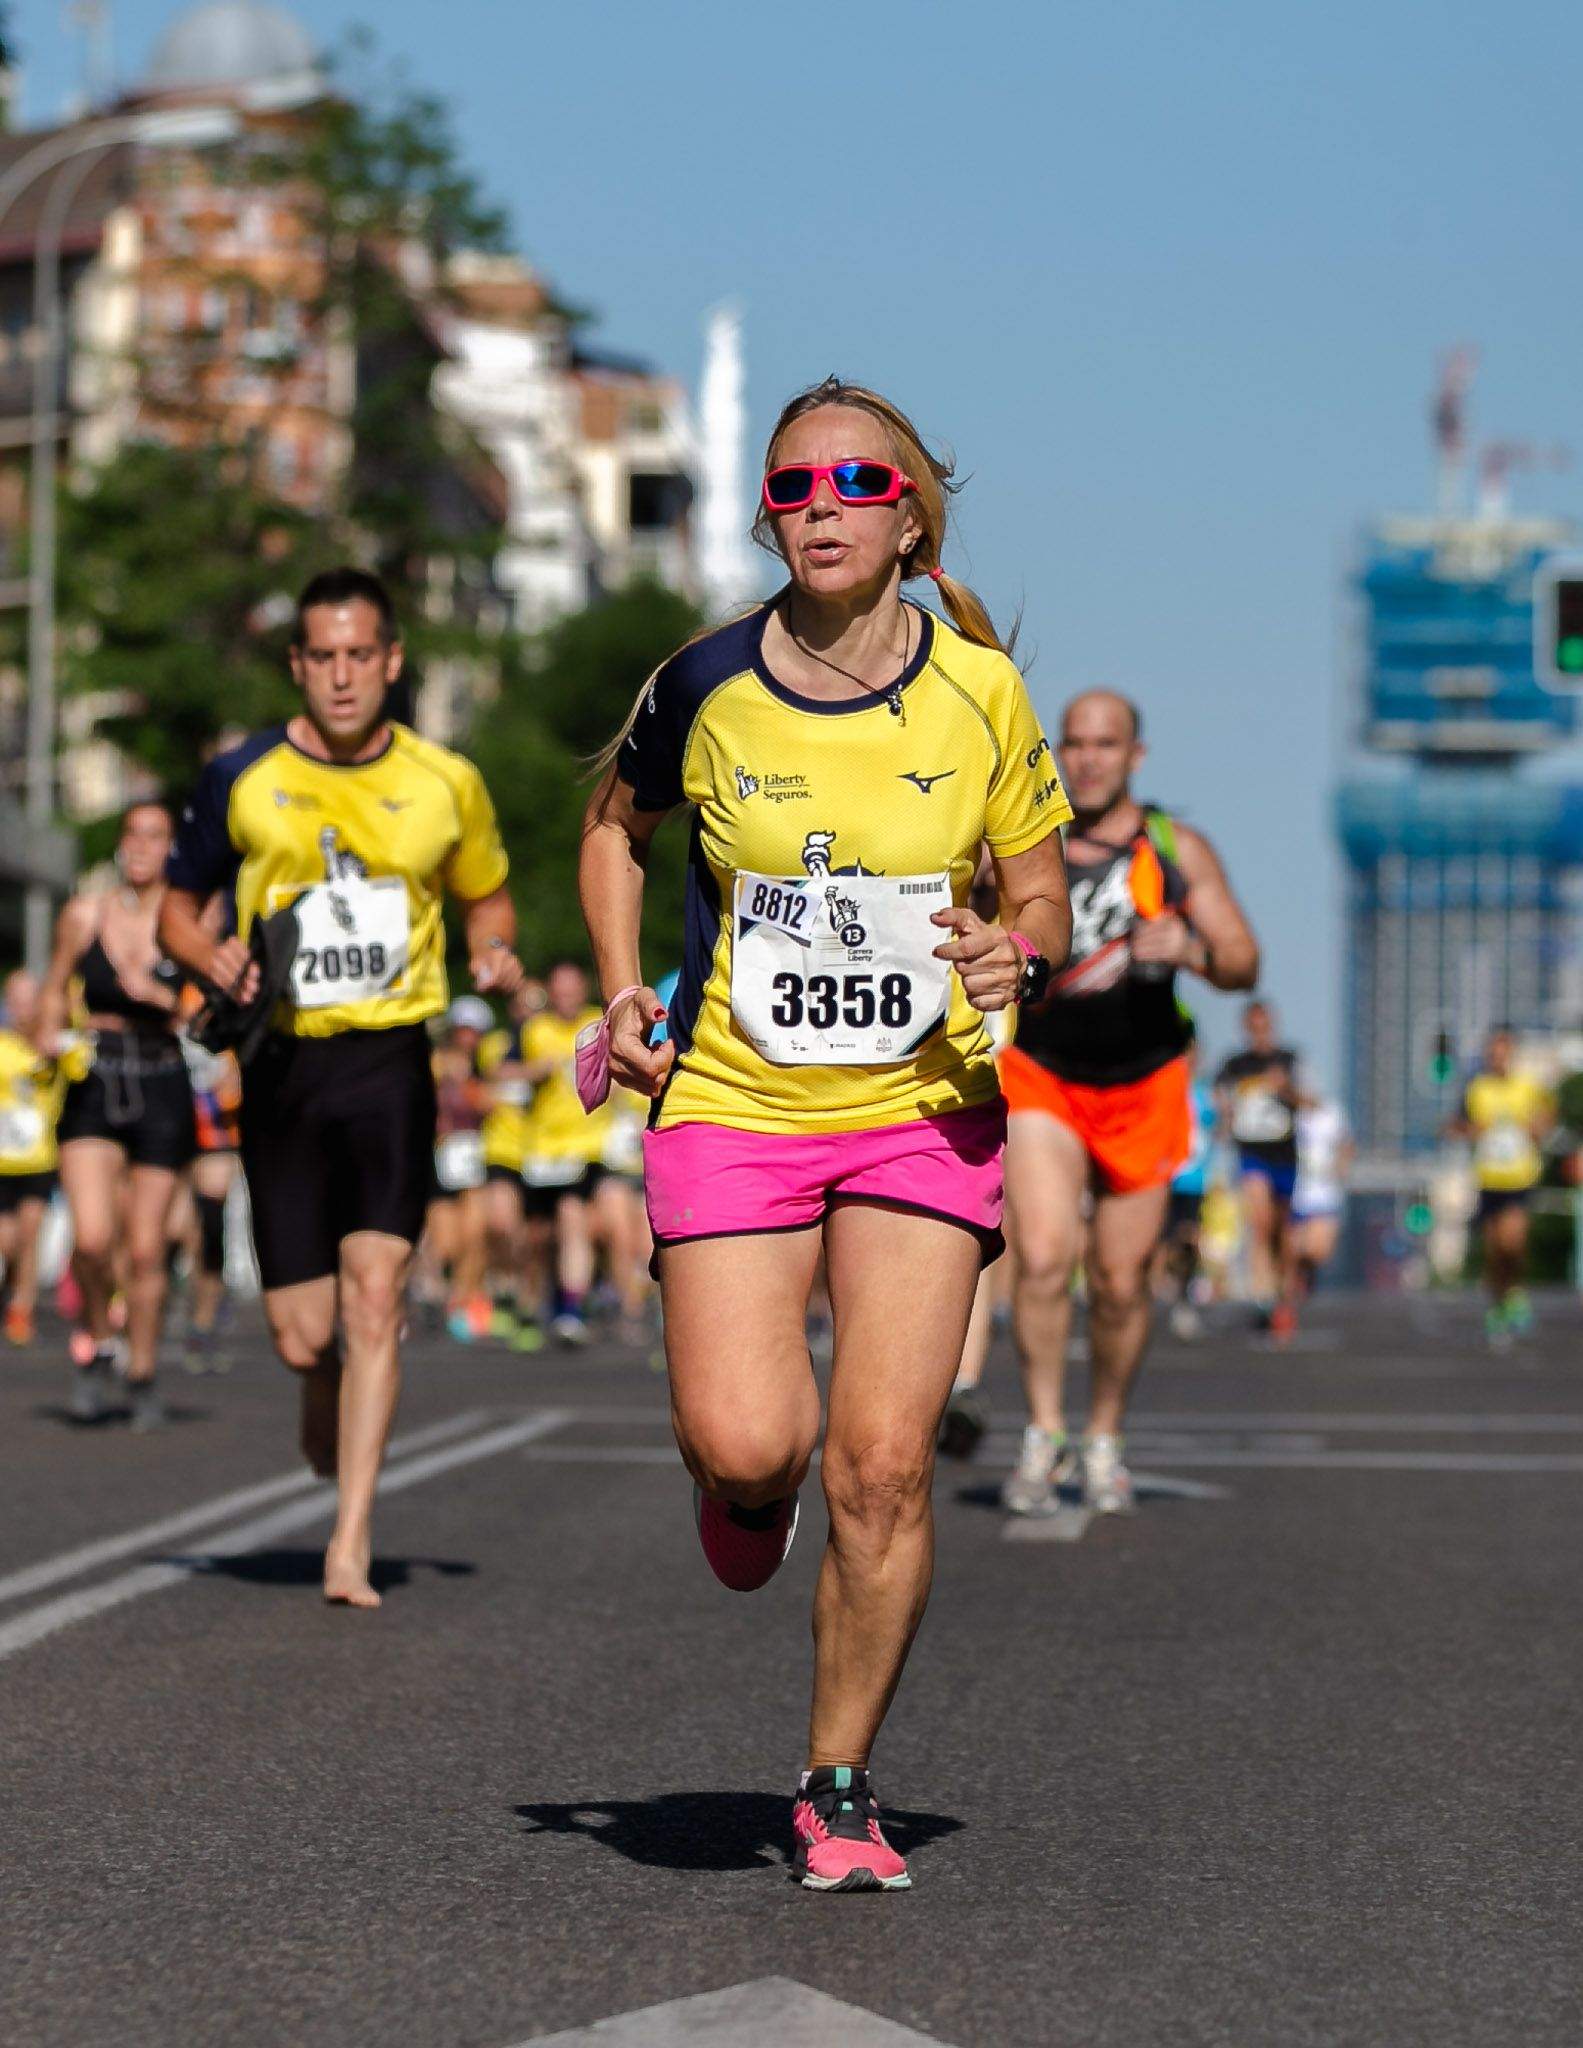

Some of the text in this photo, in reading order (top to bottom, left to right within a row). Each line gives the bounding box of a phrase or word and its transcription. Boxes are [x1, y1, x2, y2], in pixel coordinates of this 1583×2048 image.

[764, 773, 807, 788] Liberty
[763, 789, 812, 804] Seguros.
[751, 882, 807, 930] 8812
[845, 928, 861, 943] 13
[298, 943, 386, 983] 2098
[771, 971, 913, 1030] 3358
